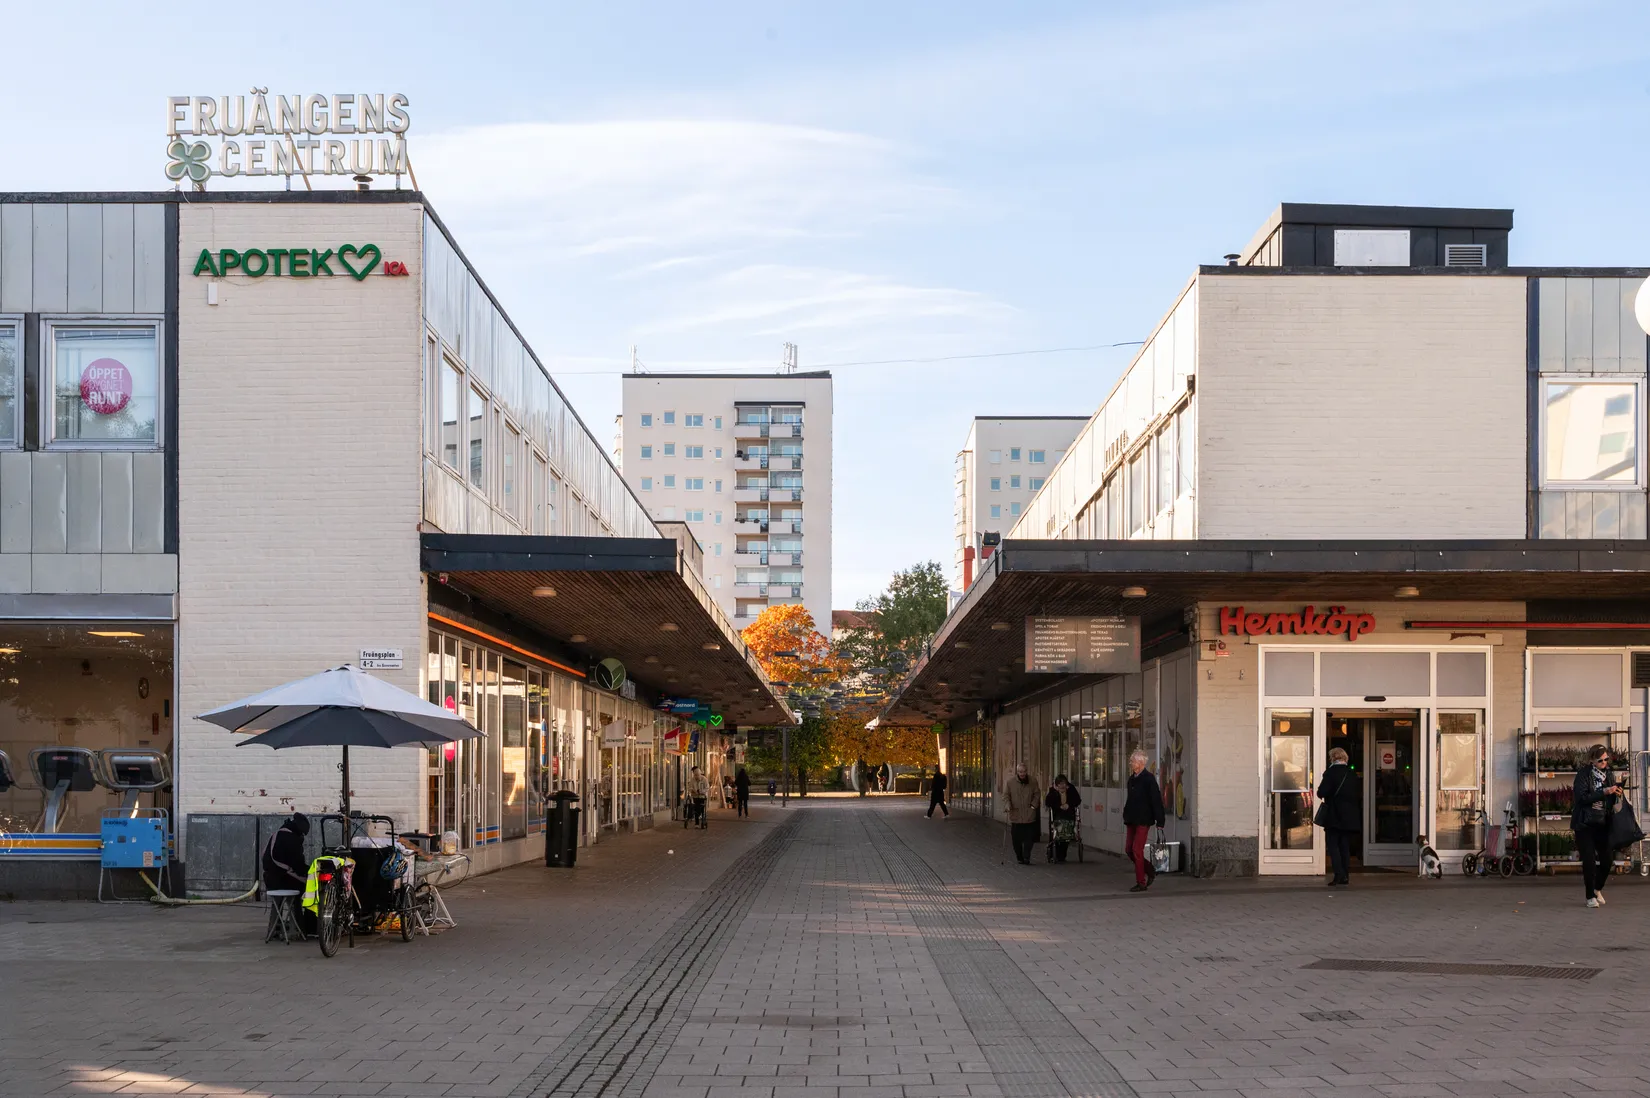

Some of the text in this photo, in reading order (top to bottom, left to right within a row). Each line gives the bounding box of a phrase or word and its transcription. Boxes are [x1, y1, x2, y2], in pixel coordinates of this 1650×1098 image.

[166, 86, 410, 136] FRUÄNGENS
[220, 139, 407, 178] CENTRUM
[193, 248, 409, 277] APOTEK ICA
[90, 365, 124, 380] ÖPPET
[88, 379, 124, 391] DYGNET
[89, 391, 124, 405] RUNT
[1219, 605, 1376, 641] Hemköp
[362, 651, 396, 659] Fruängsplan
